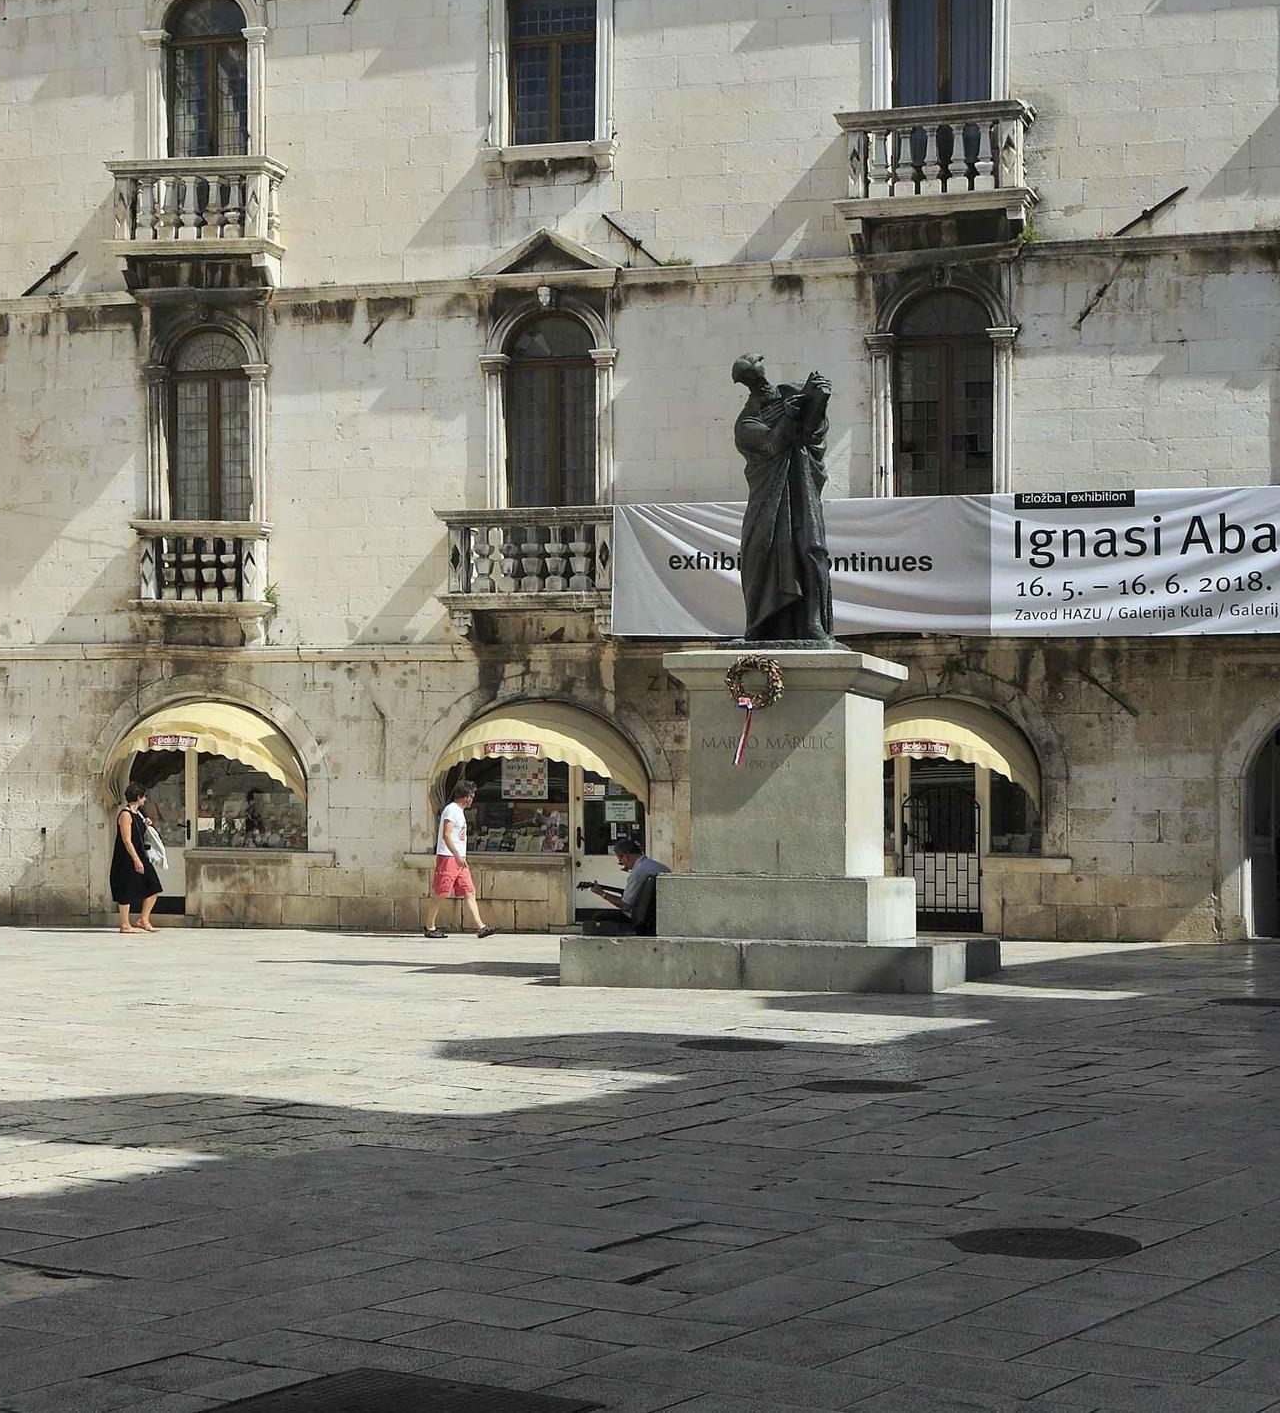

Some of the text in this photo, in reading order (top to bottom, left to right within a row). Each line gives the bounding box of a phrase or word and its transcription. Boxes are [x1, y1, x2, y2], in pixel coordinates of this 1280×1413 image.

[1022, 490, 1128, 504] izložba exhibition
[1014, 515, 1162, 569] Ignasi
[669, 551, 933, 572] exhibi ntinues
[1016, 576, 1052, 597] 16.
[1062, 581, 1083, 601] 5.
[1118, 574, 1155, 596] 16.
[1165, 573, 1188, 594] 6.
[1199, 571, 1272, 593] 2018.
[1014, 608, 1058, 621] Zavod
[1063, 608, 1102, 620] HAZU
[1118, 605, 1175, 621] Galerija
[1180, 605, 1213, 618] Kula
[700, 736, 759, 750] MARO
